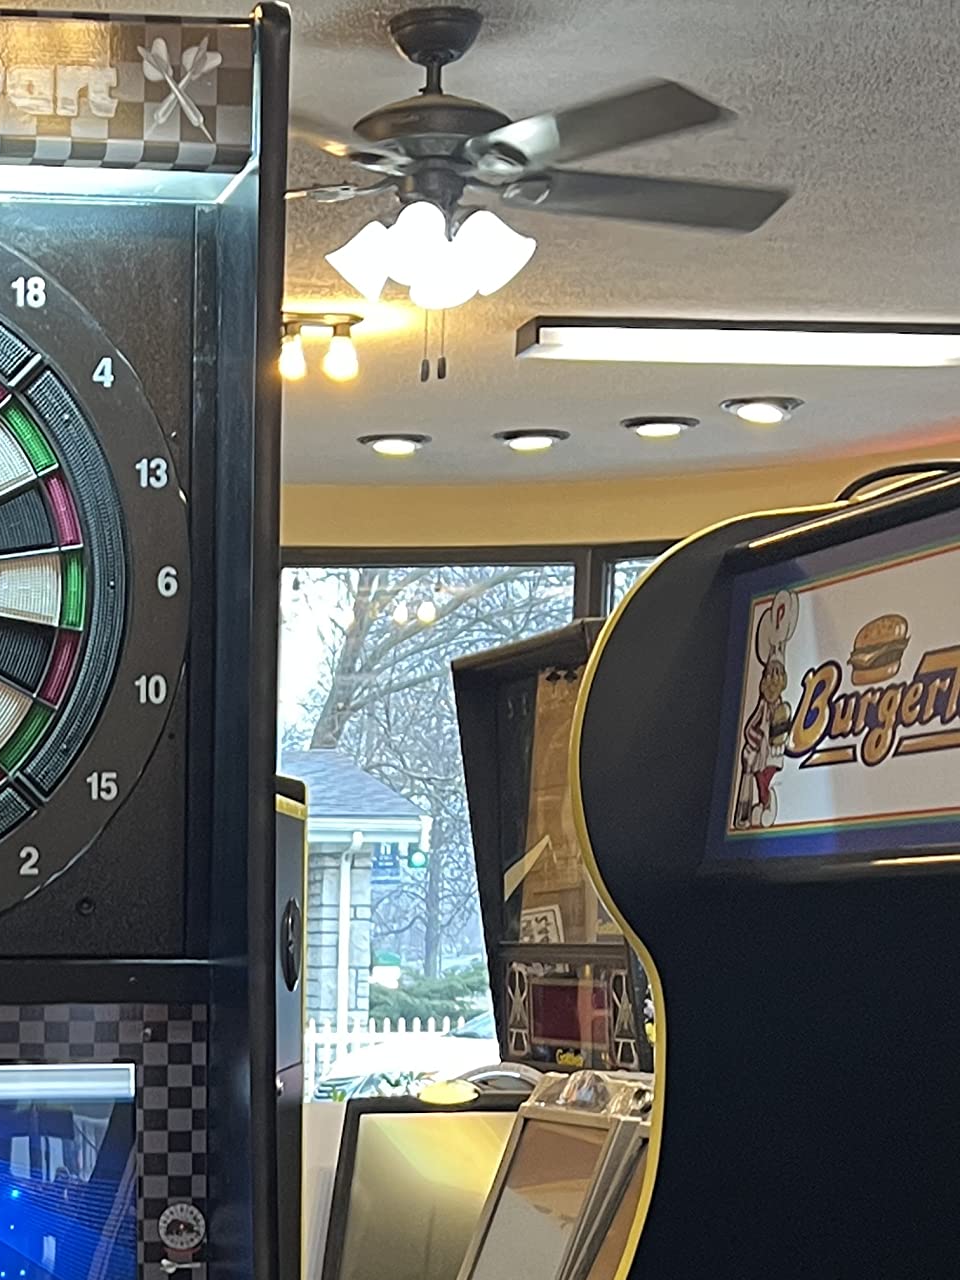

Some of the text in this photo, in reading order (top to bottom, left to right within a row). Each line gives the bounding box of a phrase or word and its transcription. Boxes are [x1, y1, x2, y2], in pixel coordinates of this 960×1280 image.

[11, 276, 46, 308] 18
[92, 357, 115, 388] 4
[135, 458, 168, 488] 13
[157, 566, 178, 597] 6
[135, 674, 167, 704] 10
[86, 772, 118, 801] 15
[19, 847, 39, 875] 2
